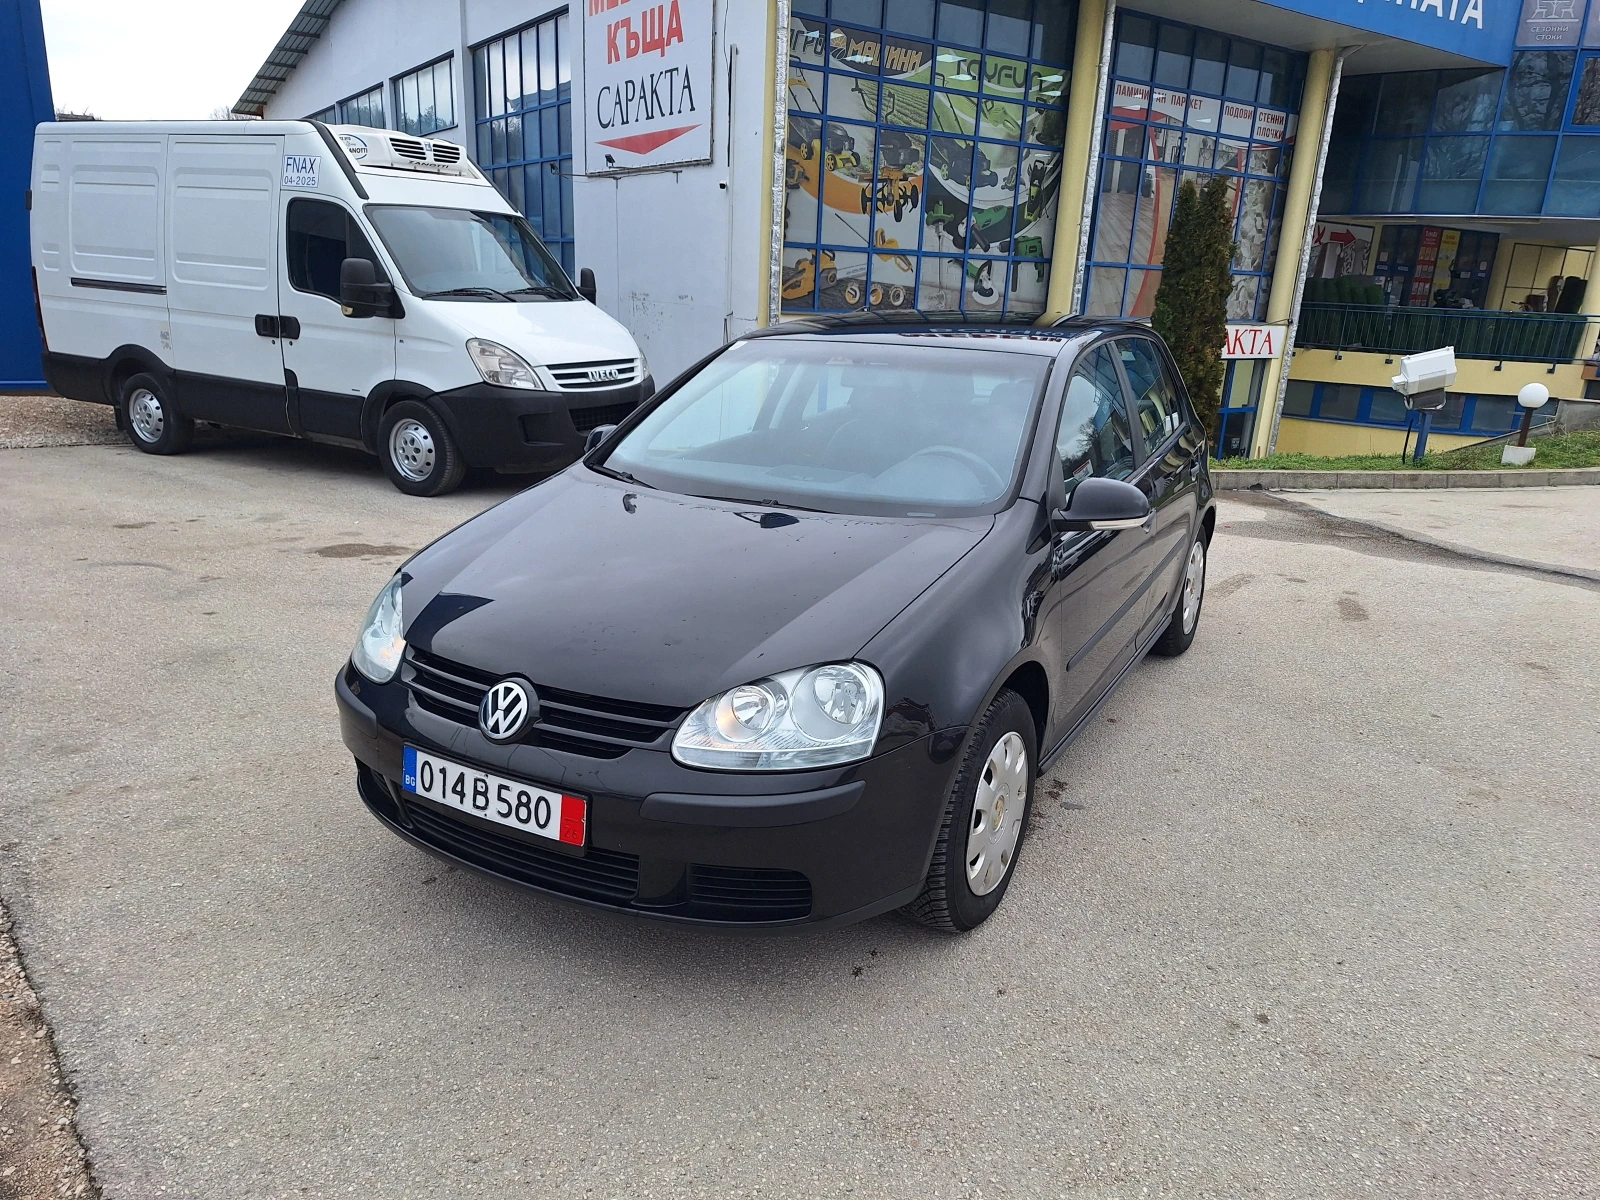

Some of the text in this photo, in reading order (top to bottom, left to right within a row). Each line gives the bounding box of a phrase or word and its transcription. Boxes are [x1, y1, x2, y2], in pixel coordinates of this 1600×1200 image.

[607, 0, 684, 65] КЪЩА
[597, 63, 696, 129] САРАКТА
[1115, 84, 1167, 104] ЛАМИНИАН
[1224, 105, 1285, 126] ПОДОВИ СТЕННИ
[285, 156, 316, 175] FNAX
[408, 160, 450, 169] ZANOTTI
[284, 175, 317, 186] 04-2025
[587, 369, 619, 382] IVECO
[405, 774, 416, 787] BG
